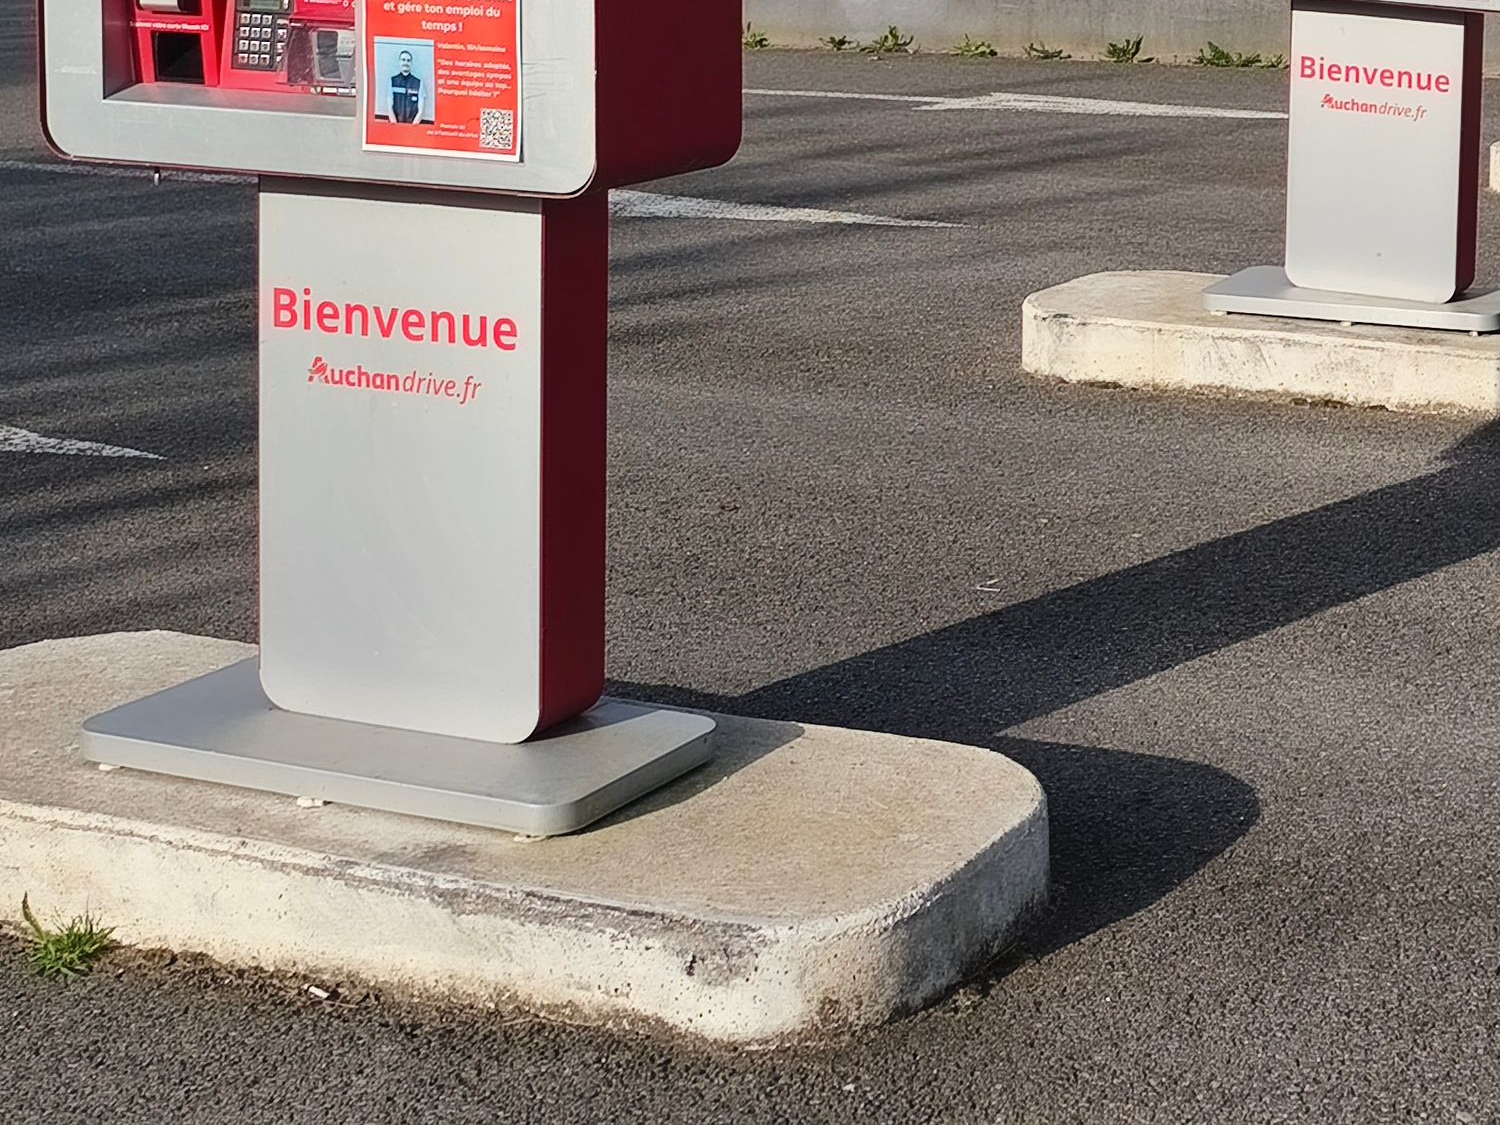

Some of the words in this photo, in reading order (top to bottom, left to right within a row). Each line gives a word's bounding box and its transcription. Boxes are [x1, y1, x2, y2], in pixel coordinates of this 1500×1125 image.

[383, 1, 395, 11] et
[424, 3, 443, 13] ton
[446, 5, 484, 17] emploi
[485, 7, 500, 17] du
[421, 20, 457, 33] temps
[1300, 56, 1450, 93] Bienvenue
[1320, 93, 1427, 121] Auchandrive.fr
[273, 287, 518, 351] Bienvenue
[308, 356, 482, 405] Auchandrive.fr
